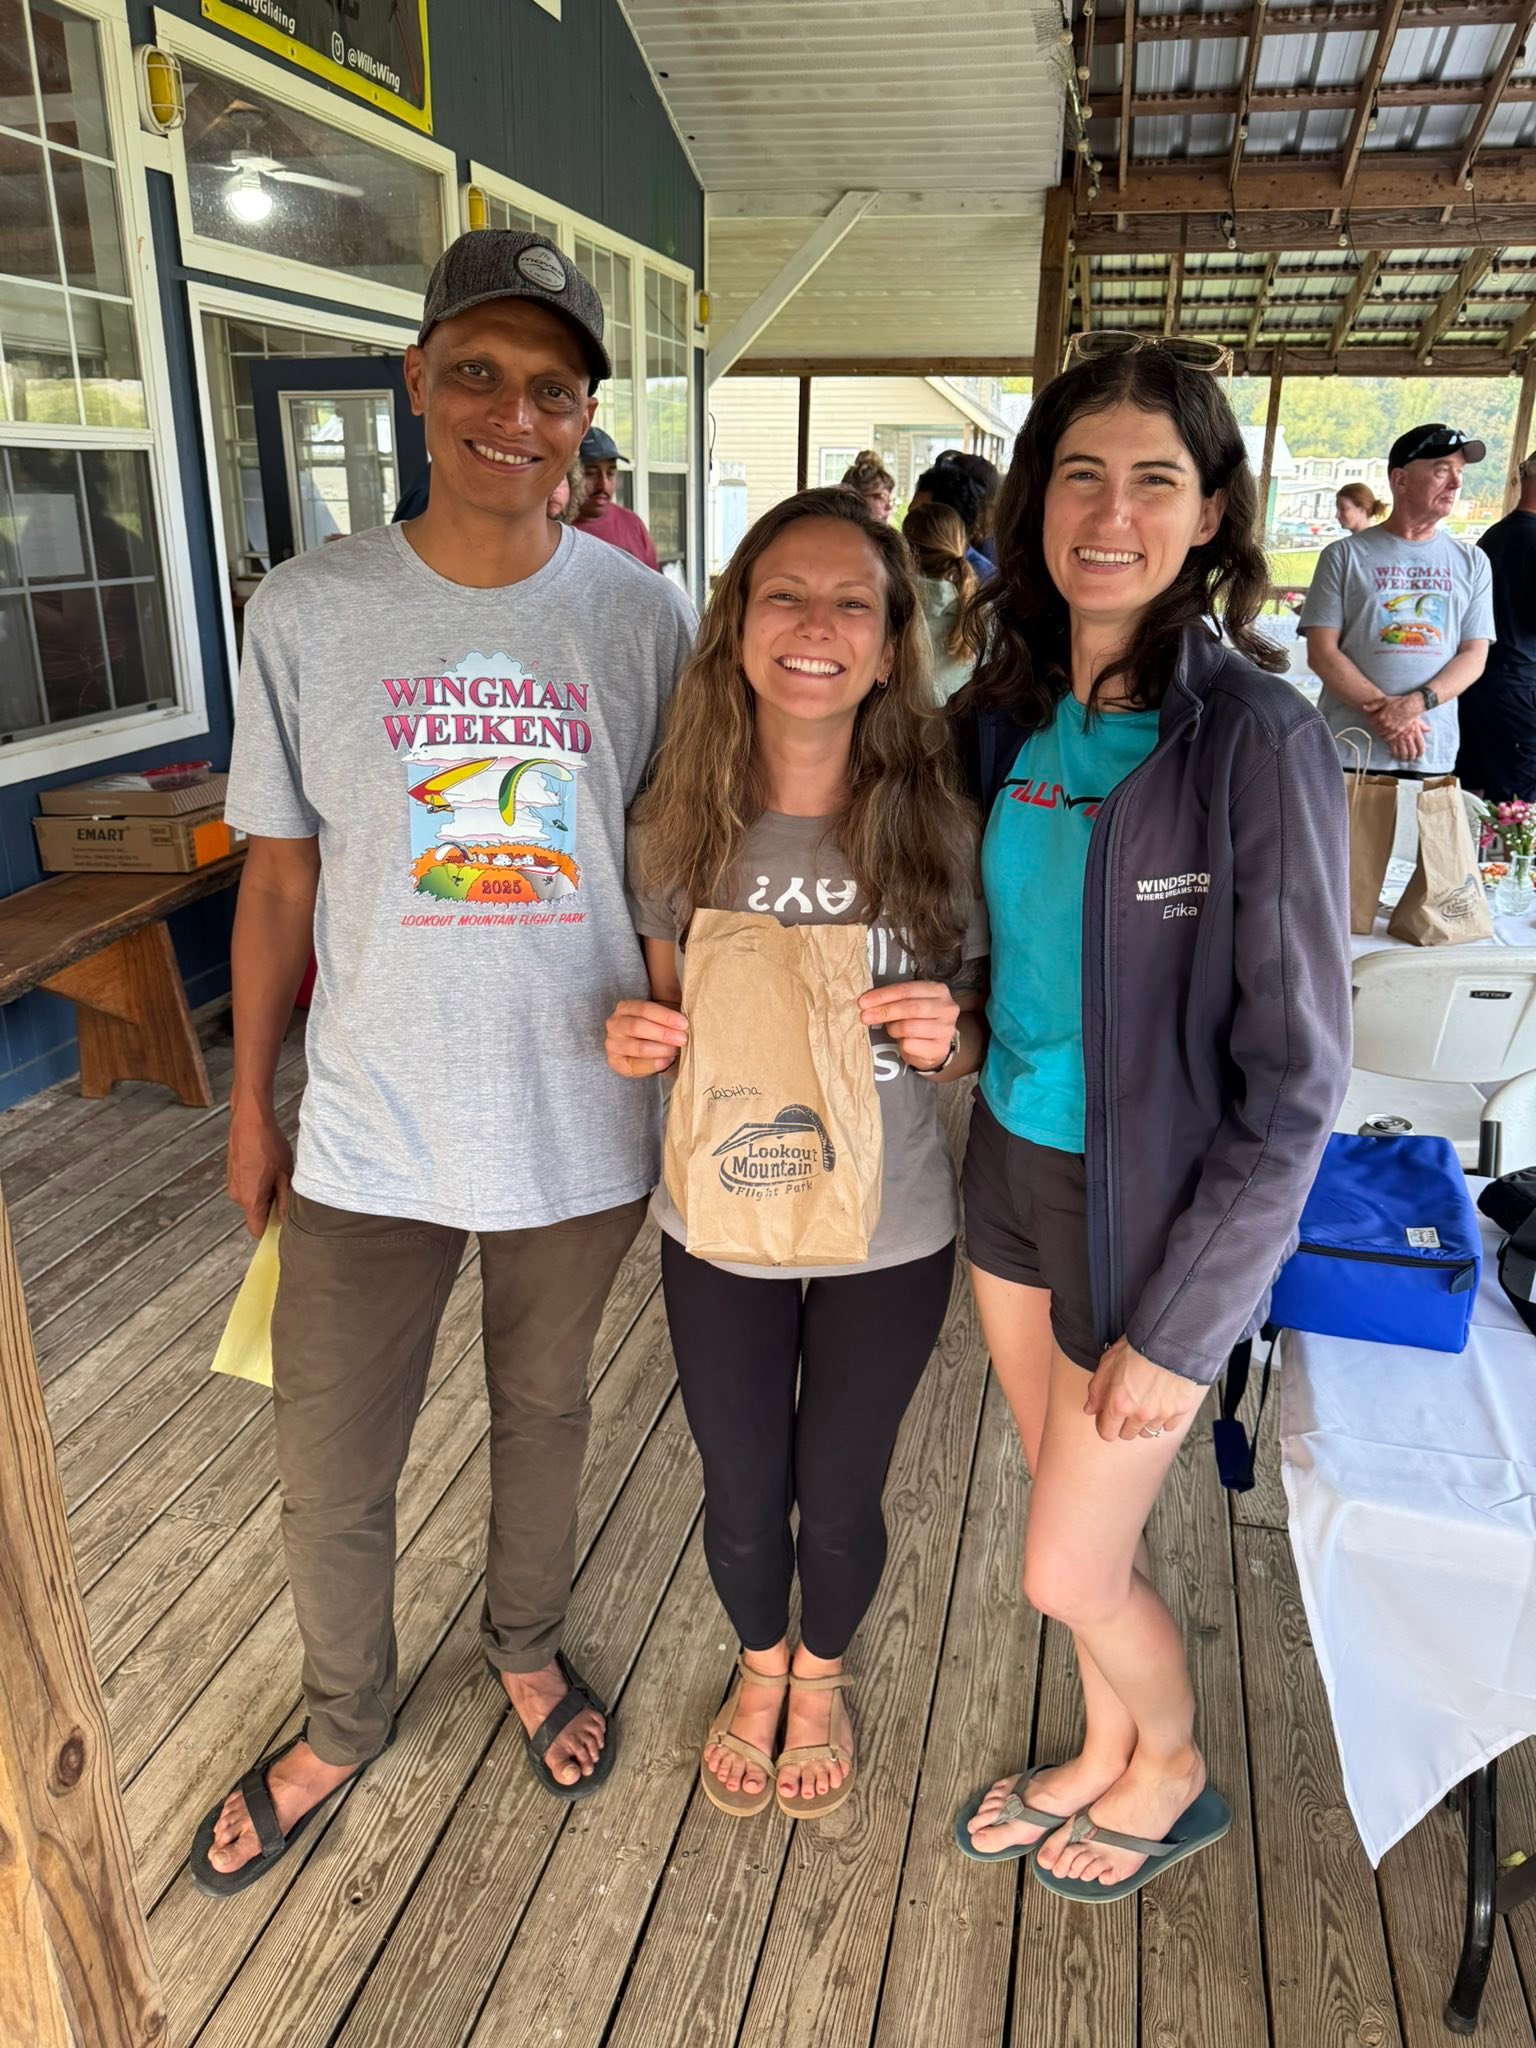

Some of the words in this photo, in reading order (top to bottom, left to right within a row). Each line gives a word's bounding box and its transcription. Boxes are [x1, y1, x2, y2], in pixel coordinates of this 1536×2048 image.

[348, 48, 400, 93] @WillsWing
[1375, 566, 1451, 578] WINGMAN
[1375, 578, 1452, 591] WEEKEND
[382, 676, 589, 713] WINGMAN
[382, 713, 592, 754] WEEKEND
[76, 827, 126, 842] EMART
[482, 880, 523, 896] 2025
[1136, 892, 1165, 902] WHERE
[401, 914, 455, 927] LOOKOUT
[457, 914, 517, 927] MOUNTAIN
[518, 913, 556, 926] FLIGHT
[558, 911, 588, 924] PARK
[1162, 902, 1198, 920] Erika
[703, 1084, 763, 1101] Tabitha
[748, 1142, 818, 1163] Lookout
[732, 1156, 813, 1180] Mountain
[735, 1186, 779, 1201] Flight
[785, 1180, 813, 1195] Park
